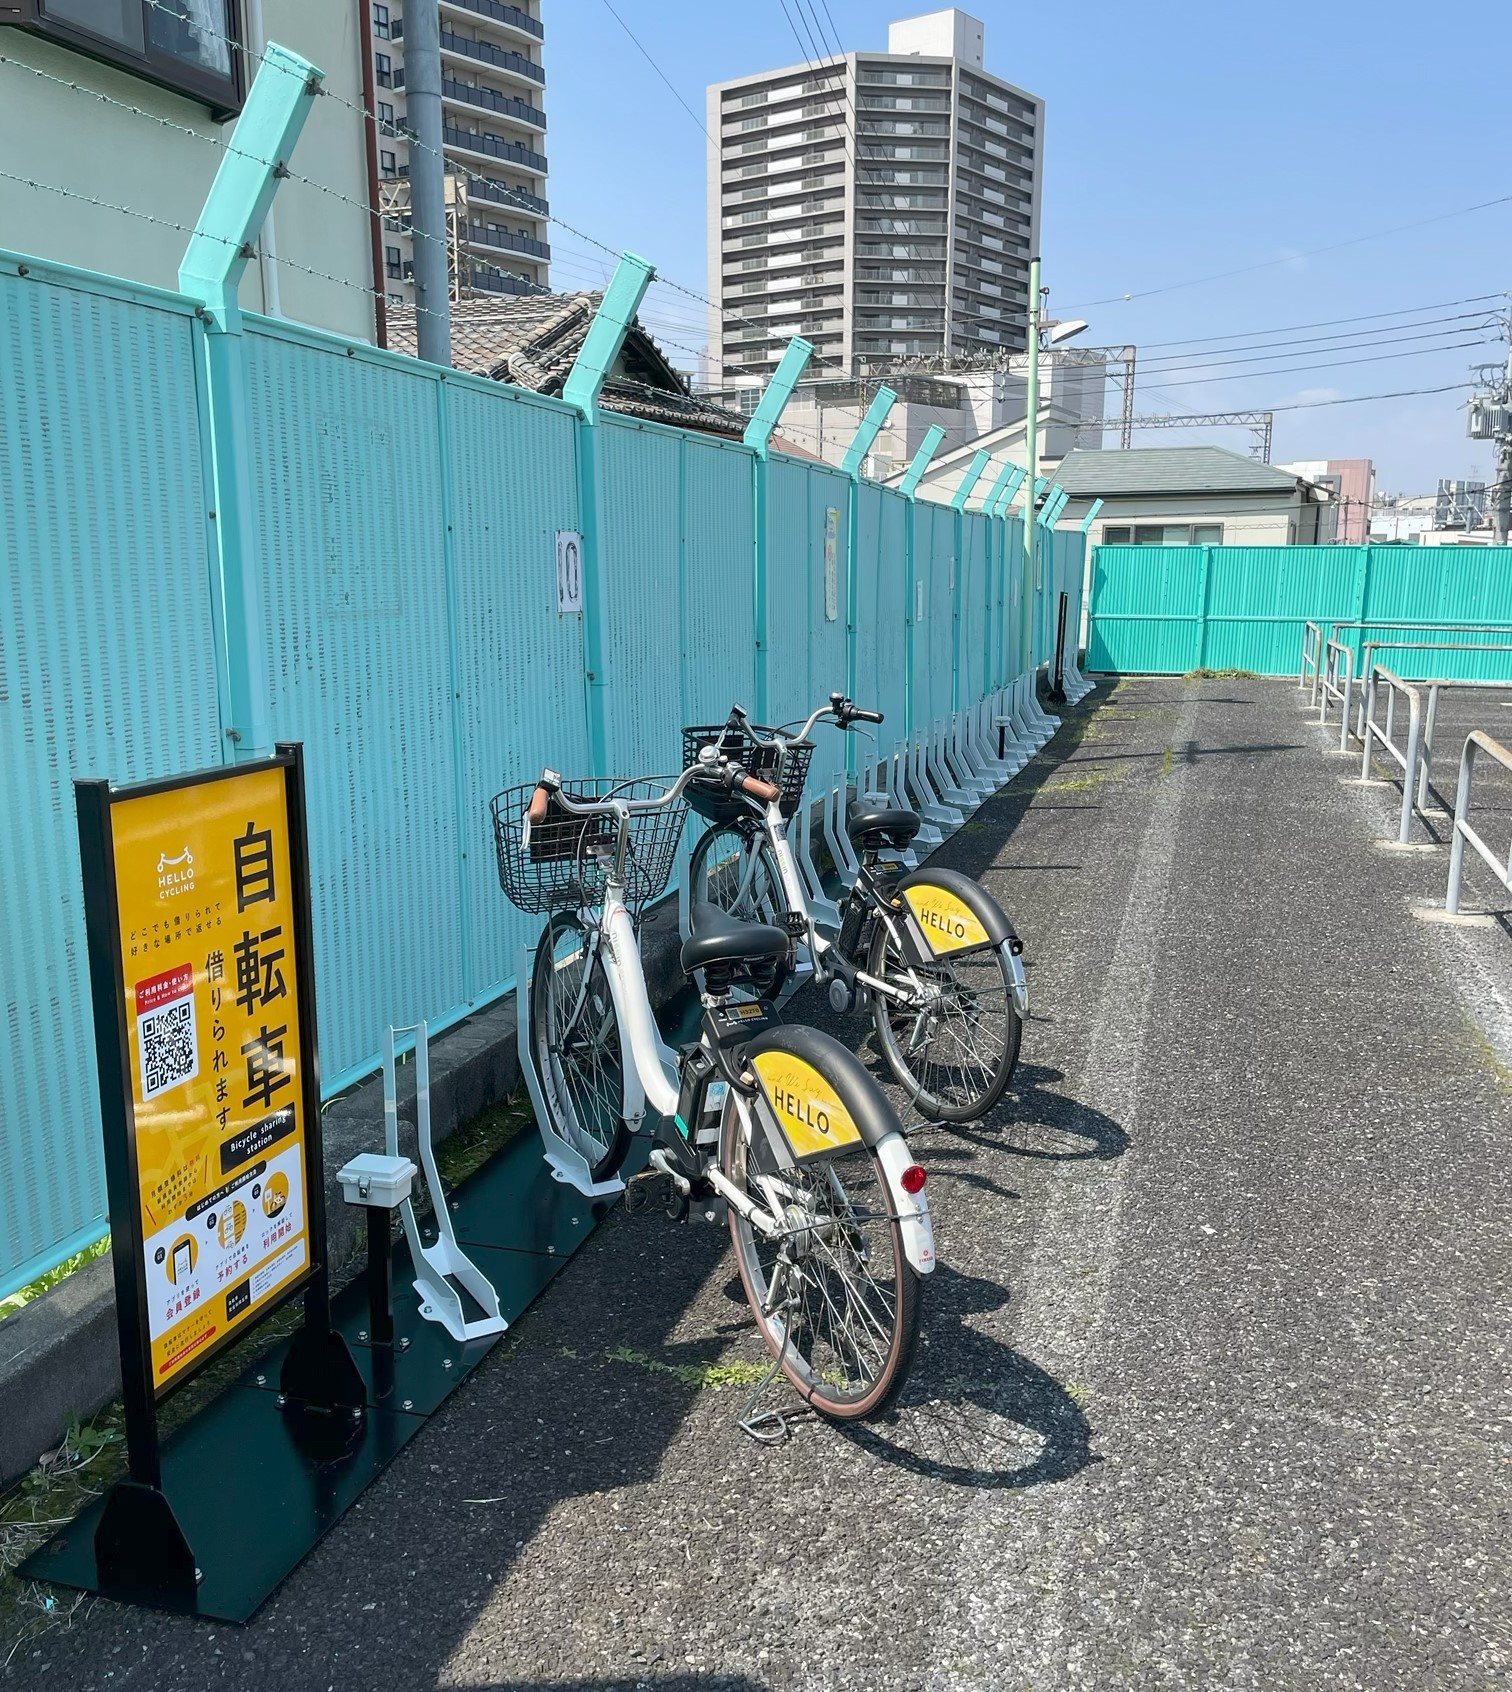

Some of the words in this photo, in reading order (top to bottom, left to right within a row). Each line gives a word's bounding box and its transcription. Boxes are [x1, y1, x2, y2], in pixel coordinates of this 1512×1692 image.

[158, 867, 194, 888] HELLO
[159, 881, 195, 900] CYCLING
[130, 902, 221, 941] どこでも借りられて
[130, 916, 222, 957] 好きな場所で返せる
[920, 907, 965, 939] HELLO
[233, 821, 291, 1110] 自転車
[205, 950, 231, 1131] 借りられます
[774, 1085, 830, 1135] HELLO
[230, 1131, 258, 1153] Bicycle
[260, 1114, 287, 1135] sharing
[246, 1134, 273, 1155] station
[262, 1222, 292, 1250] 利用開始
[217, 1253, 248, 1283] 予約する
[166, 1287, 200, 1321] 会員登録
